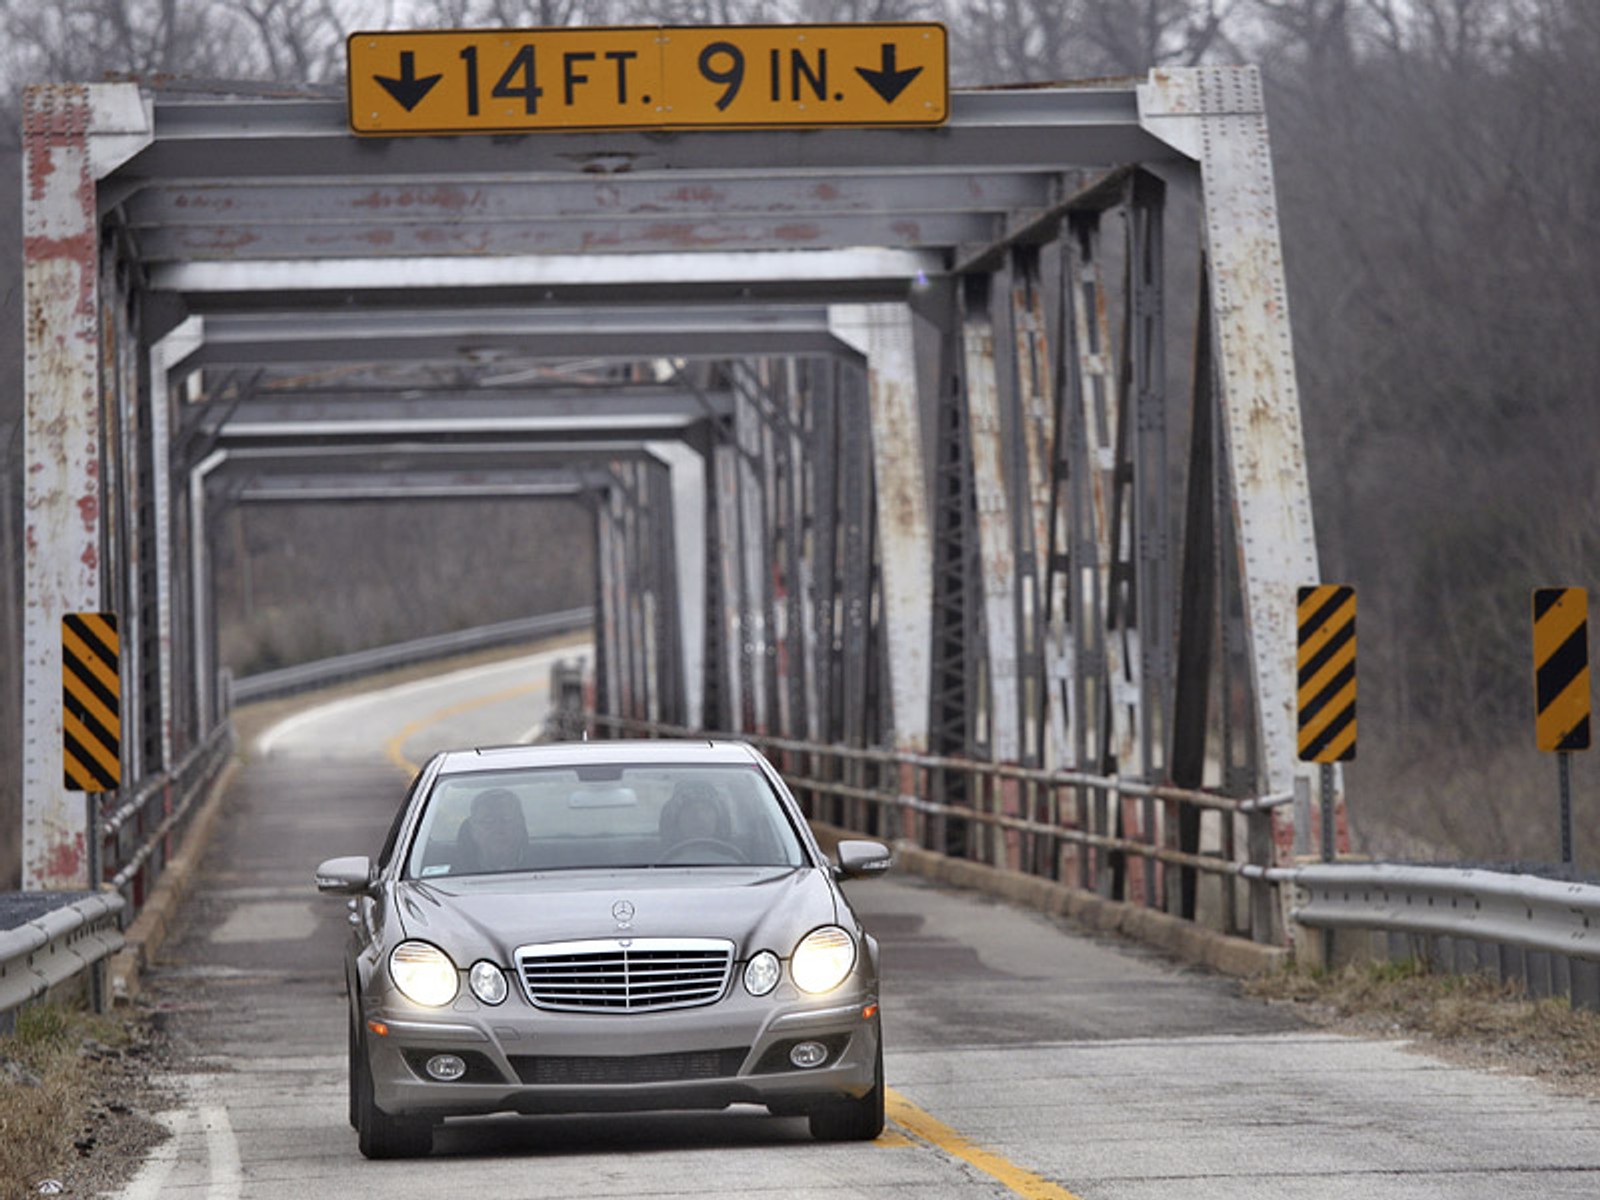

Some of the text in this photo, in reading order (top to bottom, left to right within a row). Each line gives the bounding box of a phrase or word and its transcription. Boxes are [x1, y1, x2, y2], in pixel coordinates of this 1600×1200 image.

[460, 41, 844, 116] 14 FT. 9 IN.
